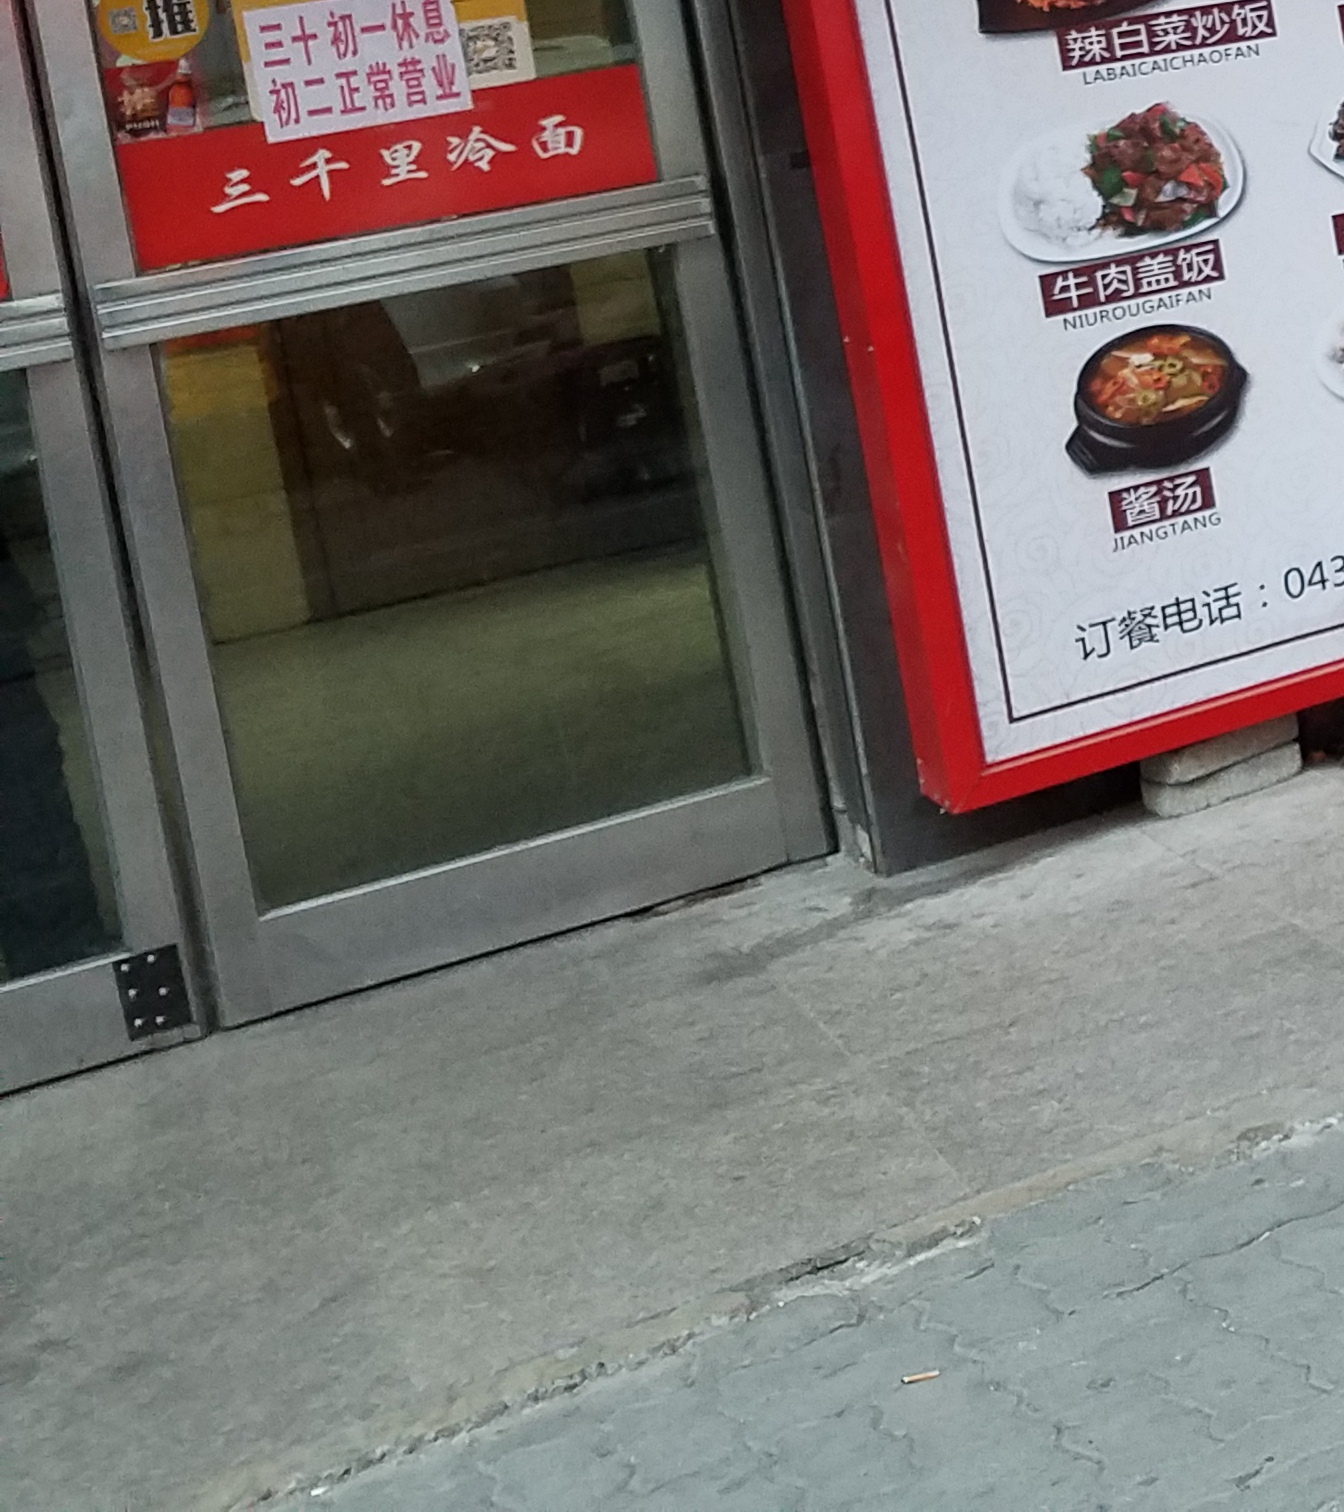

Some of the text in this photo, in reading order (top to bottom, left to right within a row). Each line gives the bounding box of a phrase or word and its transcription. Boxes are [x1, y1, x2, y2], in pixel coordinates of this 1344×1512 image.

[268, 53, 462, 129] 初二正常营业
[1082, 44, 1261, 86] LABAICAICHAOFAN
[210, 113, 584, 214] 三千里冷面
[1052, 249, 1220, 309] 牛肉盖饭
[1062, 288, 1213, 331] NIUROUGAIFAN
[1120, 474, 1203, 529] 酱汤
[1111, 511, 1222, 553] JIANGTANG
